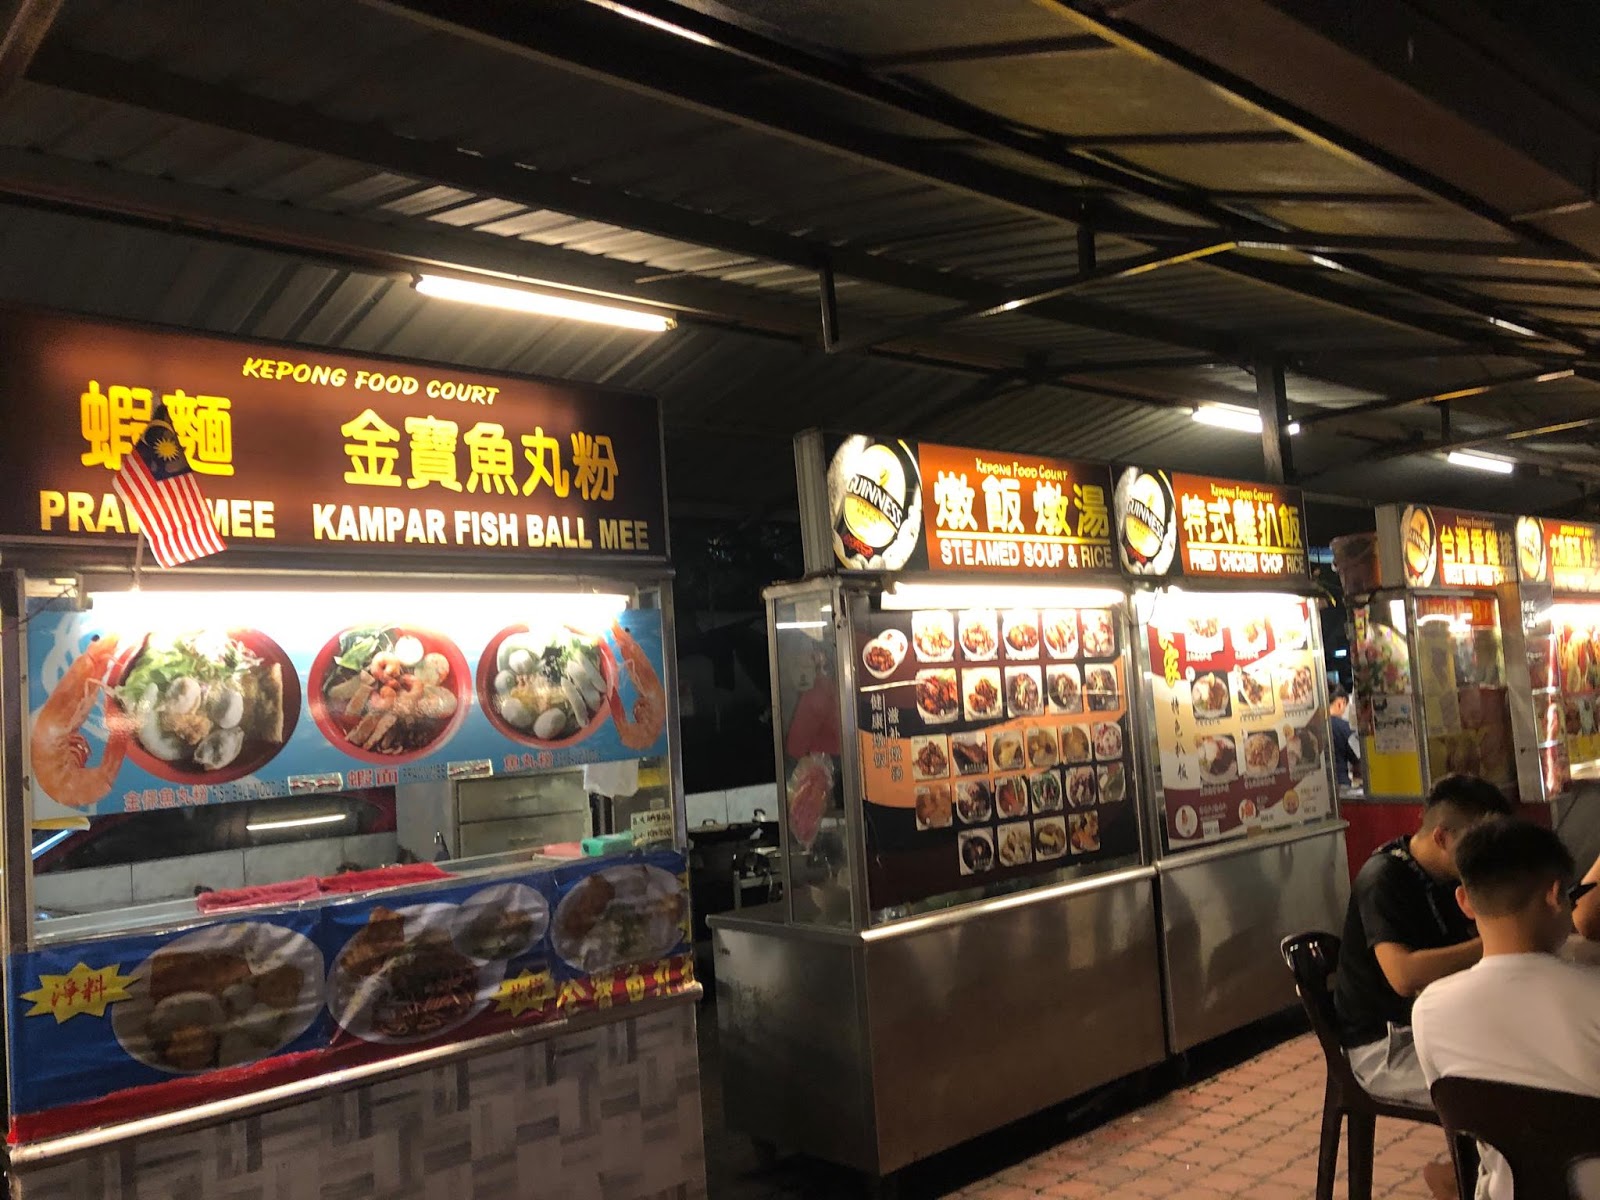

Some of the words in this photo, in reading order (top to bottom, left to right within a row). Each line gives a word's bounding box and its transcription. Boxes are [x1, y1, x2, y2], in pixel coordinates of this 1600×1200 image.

[242, 357, 347, 388] KEPONG
[354, 370, 419, 396] FOOD
[426, 379, 500, 406] COURT
[340, 408, 620, 501] 金寶魚丸粉
[39, 490, 143, 534] PRA
[204, 498, 276, 538] MEE
[847, 474, 903, 529] GUINNESS
[312, 503, 447, 544] KAMPAR
[454, 510, 519, 547] FISH
[526, 514, 593, 549] BALL
[599, 518, 650, 550] MEE
[940, 538, 1021, 567] STEAMED
[1023, 541, 1064, 569] SOUP
[1067, 544, 1079, 568] &
[1080, 545, 1114, 568] RICE
